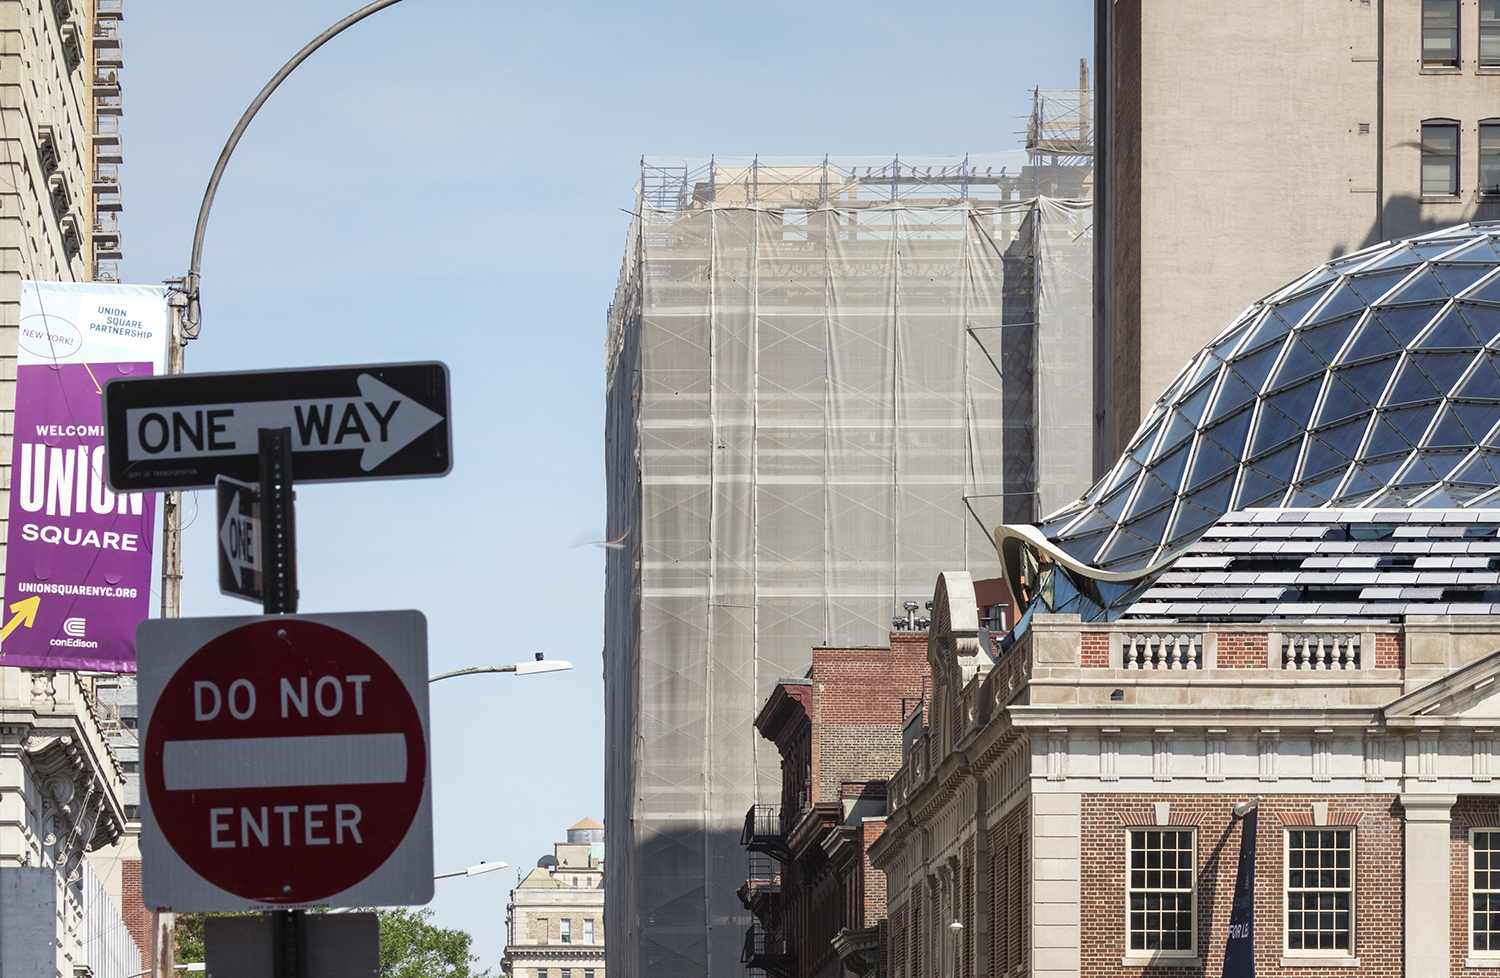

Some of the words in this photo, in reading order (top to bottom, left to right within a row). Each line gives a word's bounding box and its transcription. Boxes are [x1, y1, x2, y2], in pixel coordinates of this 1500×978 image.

[98, 306, 127, 317] UNION
[89, 322, 153, 339] PARTNERSHIP
[106, 316, 143, 329] SQUARE
[22, 328, 44, 340] NEW
[47, 333, 74, 346] YORK!
[36, 425, 104, 437] WELCOM
[138, 409, 236, 454] ONE
[294, 400, 402, 446] WAY
[153, 469, 198, 477] TRANSPORTATION
[21, 523, 139, 552] SQUARE
[229, 515, 254, 564] ONE
[18, 582, 138, 598] UNIONSQUARENYC.ORG
[50, 638, 98, 648] conEdison
[194, 678, 256, 721] DO
[280, 675, 371, 718] NOT
[210, 803, 363, 849] ENTER
[1228, 924, 1241, 939] FOR
